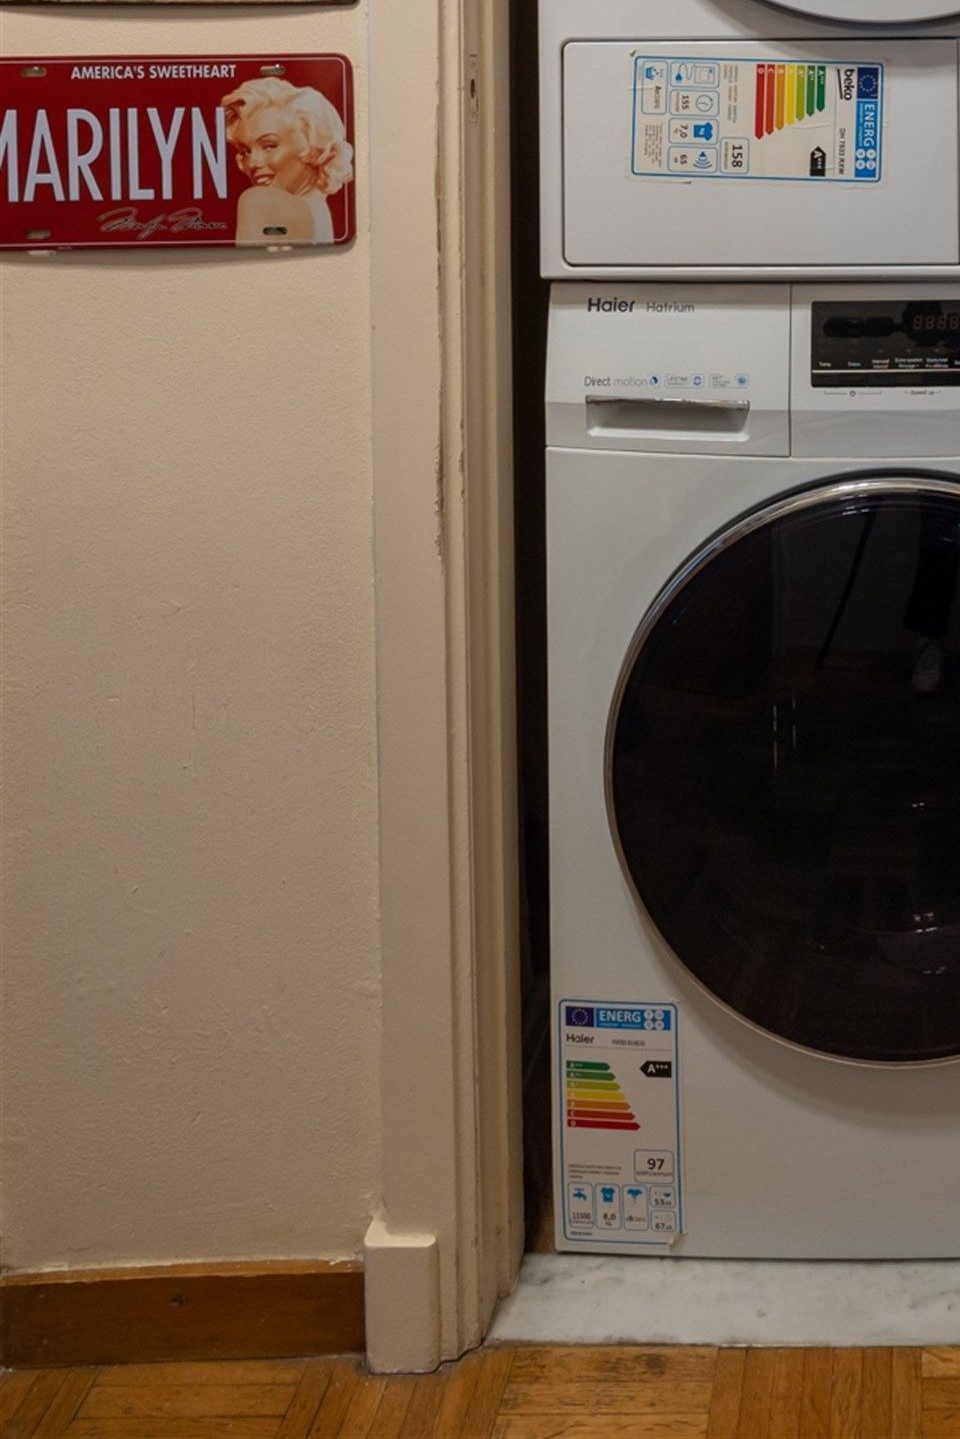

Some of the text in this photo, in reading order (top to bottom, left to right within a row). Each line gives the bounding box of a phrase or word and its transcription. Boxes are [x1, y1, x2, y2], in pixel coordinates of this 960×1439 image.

[70, 64, 237, 81] AMERICA'S SWEETHEART
[843, 68, 857, 102] beko
[681, 95, 689, 110] 155
[863, 102, 877, 148] ENERG
[732, 144, 743, 168] 158
[587, 297, 696, 313] Haier Hatrium
[584, 376, 612, 388] Direct
[599, 1010, 642, 1023] ENERG
[566, 1033, 595, 1045] Haier
[647, 1062, 669, 1074] A+++
[646, 1157, 665, 1171] 97
